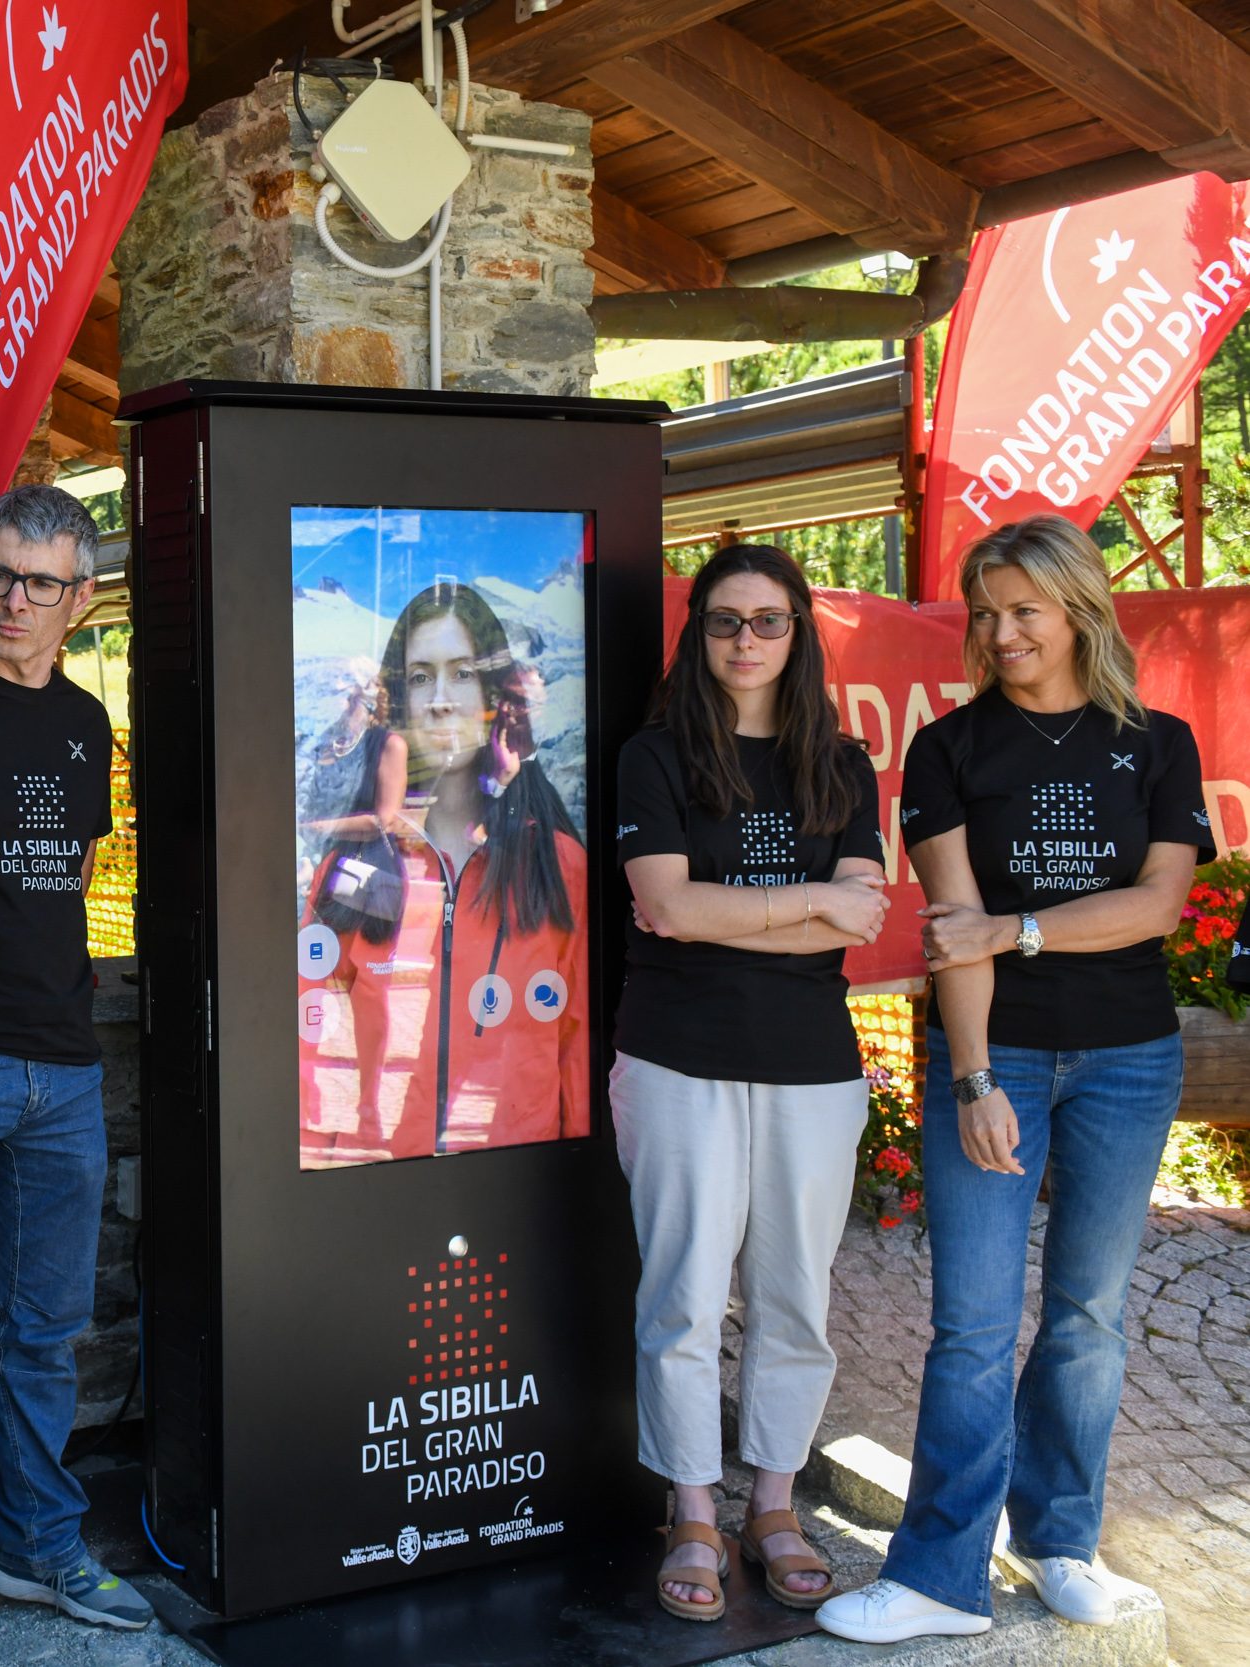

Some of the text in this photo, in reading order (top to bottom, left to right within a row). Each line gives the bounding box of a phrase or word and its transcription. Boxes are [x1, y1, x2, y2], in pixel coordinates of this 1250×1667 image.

[75, 12, 170, 219] PARADIS
[1036, 215, 1250, 507] GRAND PARA
[960, 268, 1172, 527] FONDATION
[3, 840, 82, 856] LA SIBILLA
[1013, 841, 1116, 857] LA SIBILLA
[0, 859, 67, 873] DEL GRAN
[1009, 860, 1094, 875] DEL GRAN
[22, 877, 82, 891] PARADISO
[1033, 876, 1110, 891] PARADISO
[368, 1374, 540, 1434] LA SIBILLA
[362, 1421, 503, 1474] DEL GRAN
[407, 1451, 546, 1503] PARADISO
[479, 1517, 533, 1538] FONDATION
[490, 1520, 565, 1546] GRAND PARADIS
[423, 1538, 442, 1551] Valle
[341, 1553, 367, 1567] Vallée
